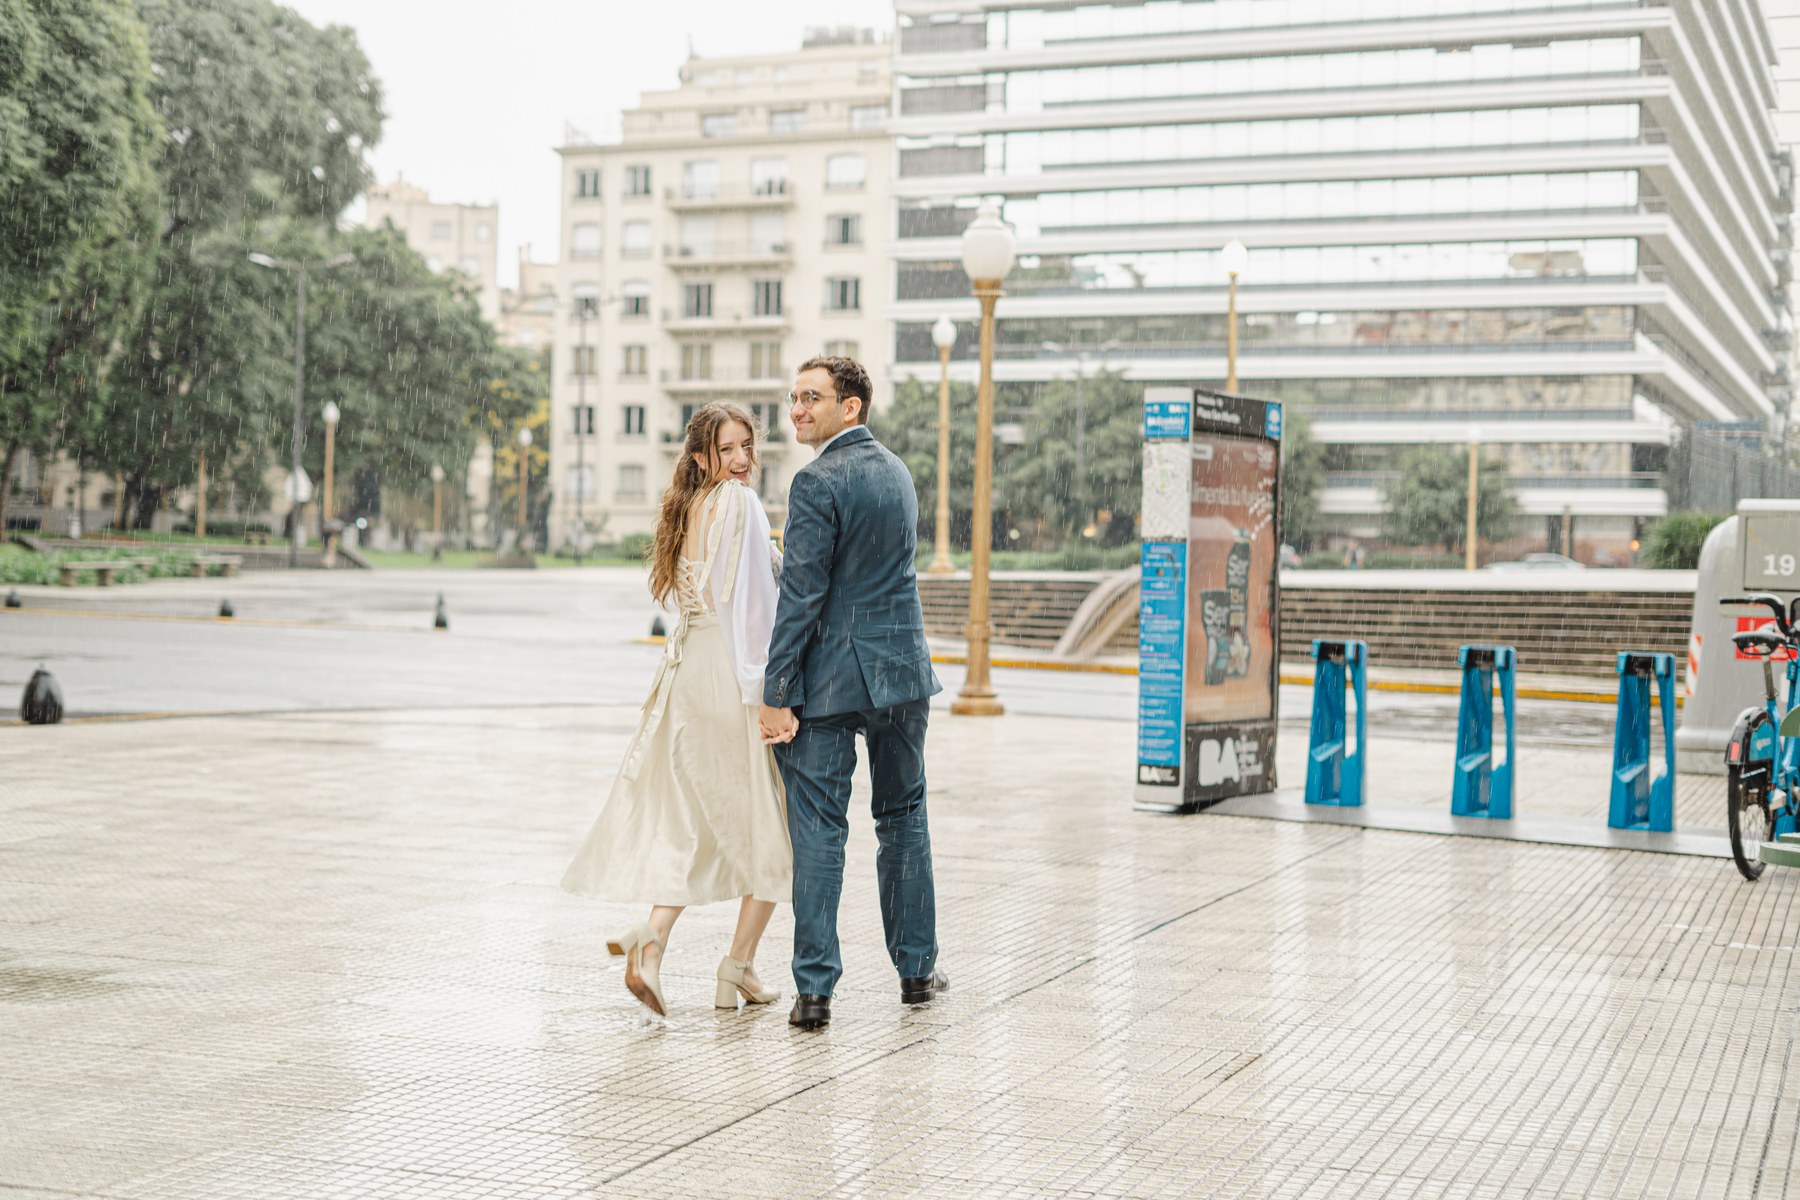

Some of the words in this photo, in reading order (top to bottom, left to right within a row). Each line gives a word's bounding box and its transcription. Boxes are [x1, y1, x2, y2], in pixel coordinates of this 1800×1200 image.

[1228, 554, 1249, 577] Ser
[1763, 554, 1796, 576] 19
[1203, 600, 1229, 625] Ser
